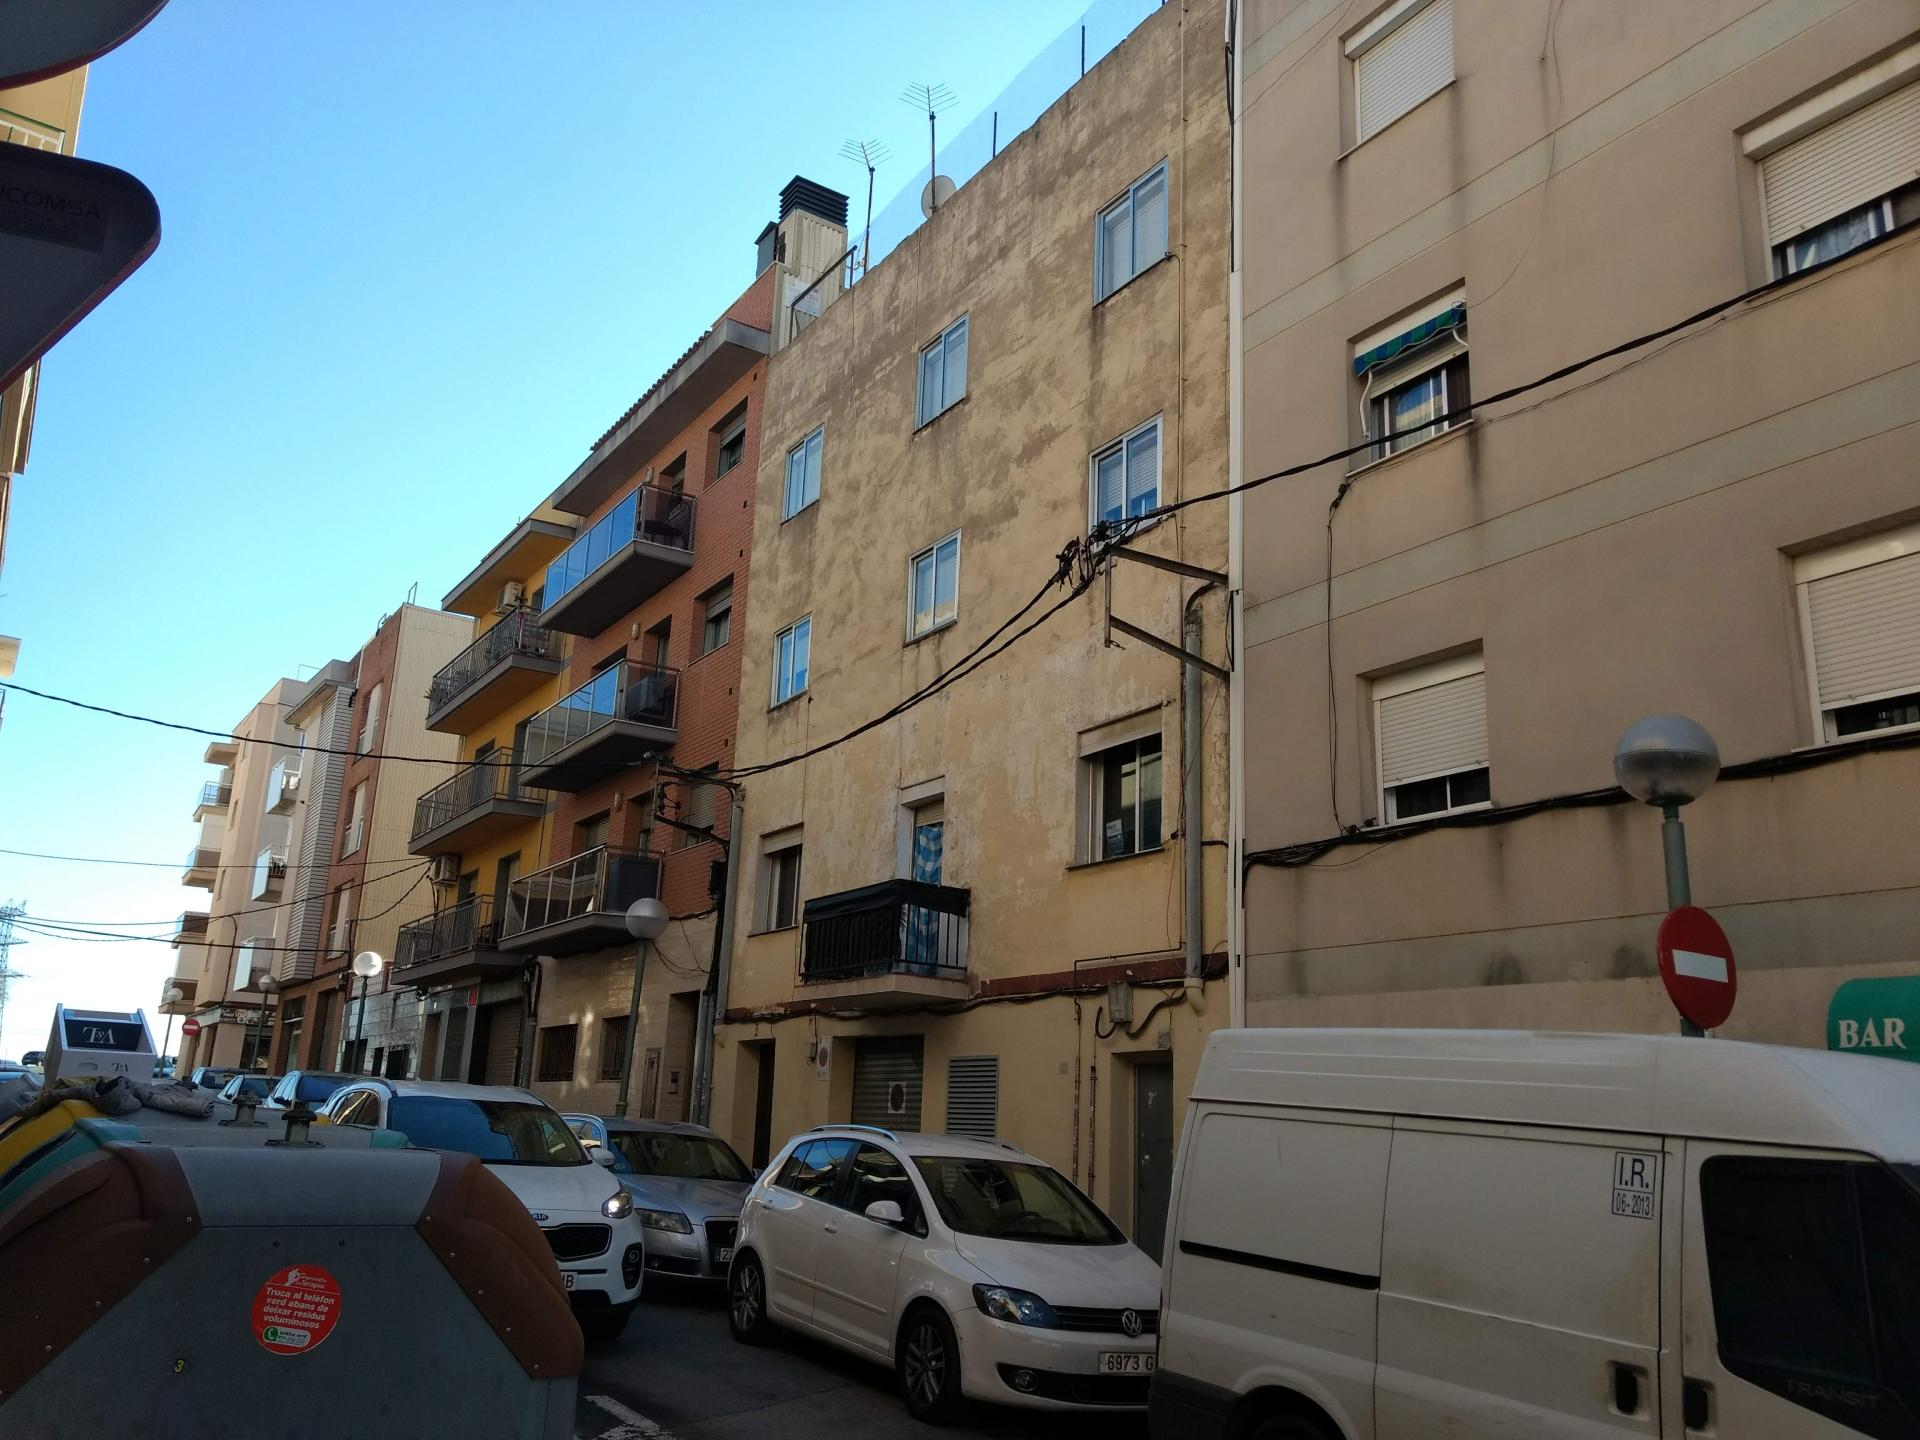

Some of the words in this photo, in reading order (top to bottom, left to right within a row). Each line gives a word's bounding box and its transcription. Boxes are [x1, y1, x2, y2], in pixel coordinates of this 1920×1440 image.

[0, 184, 101, 220] COMSA
[1838, 1017, 1906, 1049] BAR
[1619, 1157, 1649, 1188] I.R.
[266, 1287, 291, 1298] Truca
[263, 1305, 292, 1316] deixar
[293, 1310, 326, 1321] residus
[266, 1297, 287, 1306] verd
[288, 1300, 315, 1311] abans
[317, 1304, 329, 1313] de
[263, 1315, 320, 1329] voluminosos
[174, 1359, 185, 1373] 3
[1107, 1354, 1140, 1371] 6973
[1786, 1379, 1880, 1409] TRANSIT
